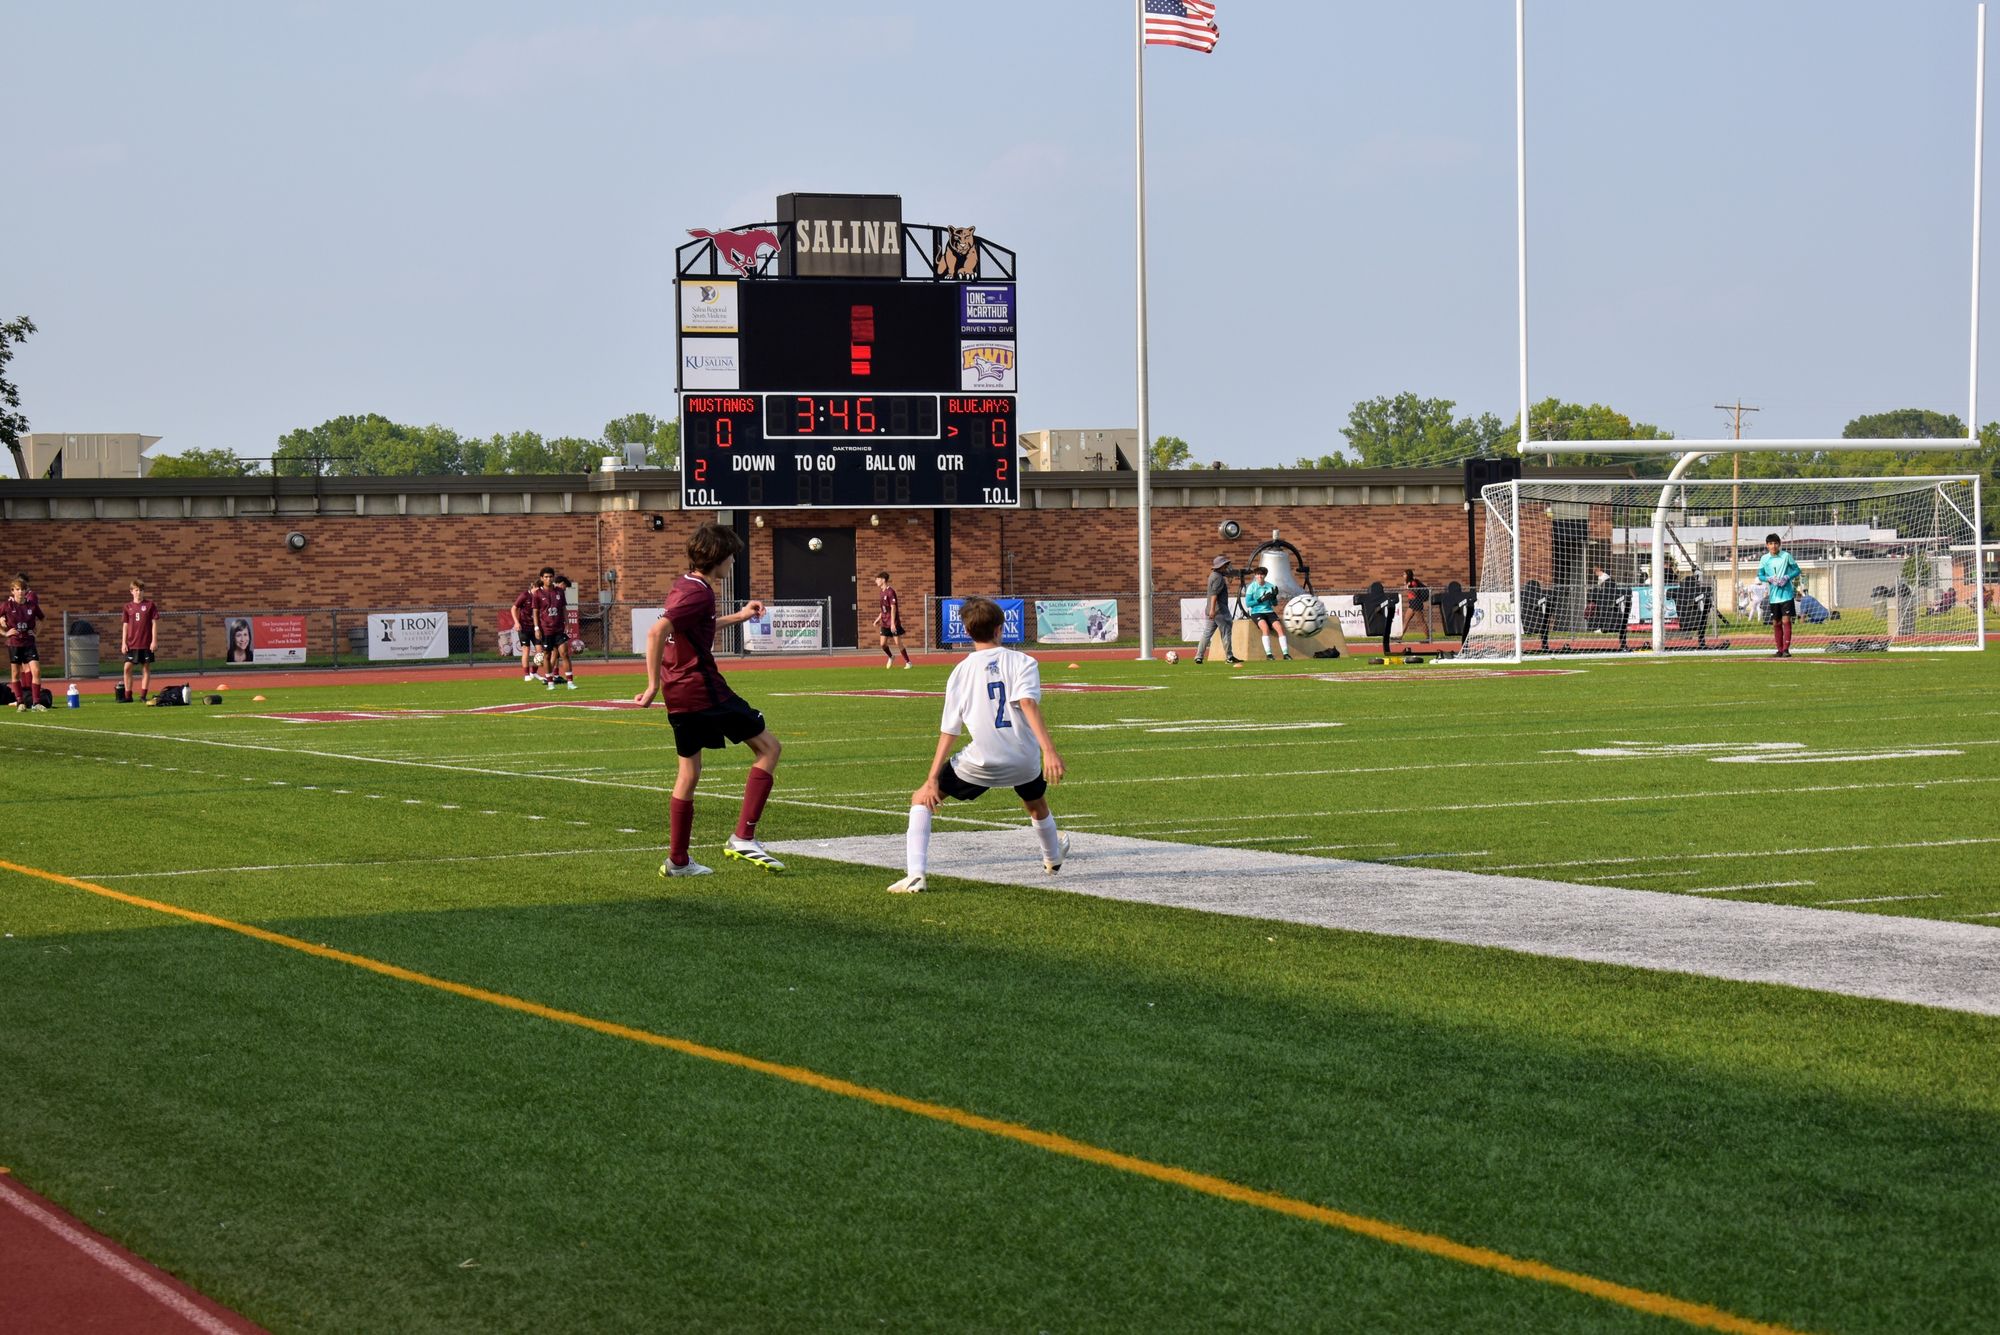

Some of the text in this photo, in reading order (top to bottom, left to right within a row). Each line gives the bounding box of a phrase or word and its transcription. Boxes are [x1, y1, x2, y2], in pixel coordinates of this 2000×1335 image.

[796, 220, 900, 254] SALINA
[966, 292, 986, 304] LONG
[966, 306, 1008, 318] McARTHUR
[686, 356, 704, 369] KU
[963, 347, 1013, 370] KWU
[690, 398, 754, 412] MUSTANGS
[949, 399, 1009, 413] BLUEJAYS
[716, 418, 732, 447] 0
[992, 418, 1007, 447] 0
[694, 459, 707, 481] 2
[732, 455, 775, 471] DOWN
[794, 455, 836, 471] TO GO
[866, 455, 915, 471] BALL ON
[937, 455, 964, 471] QTR
[996, 458, 1008, 480] 2
[688, 489, 722, 505] T.O.L.
[983, 488, 1015, 503] T.O.L.
[400, 618, 436, 630] IRON
[987, 681, 1012, 728] 2
